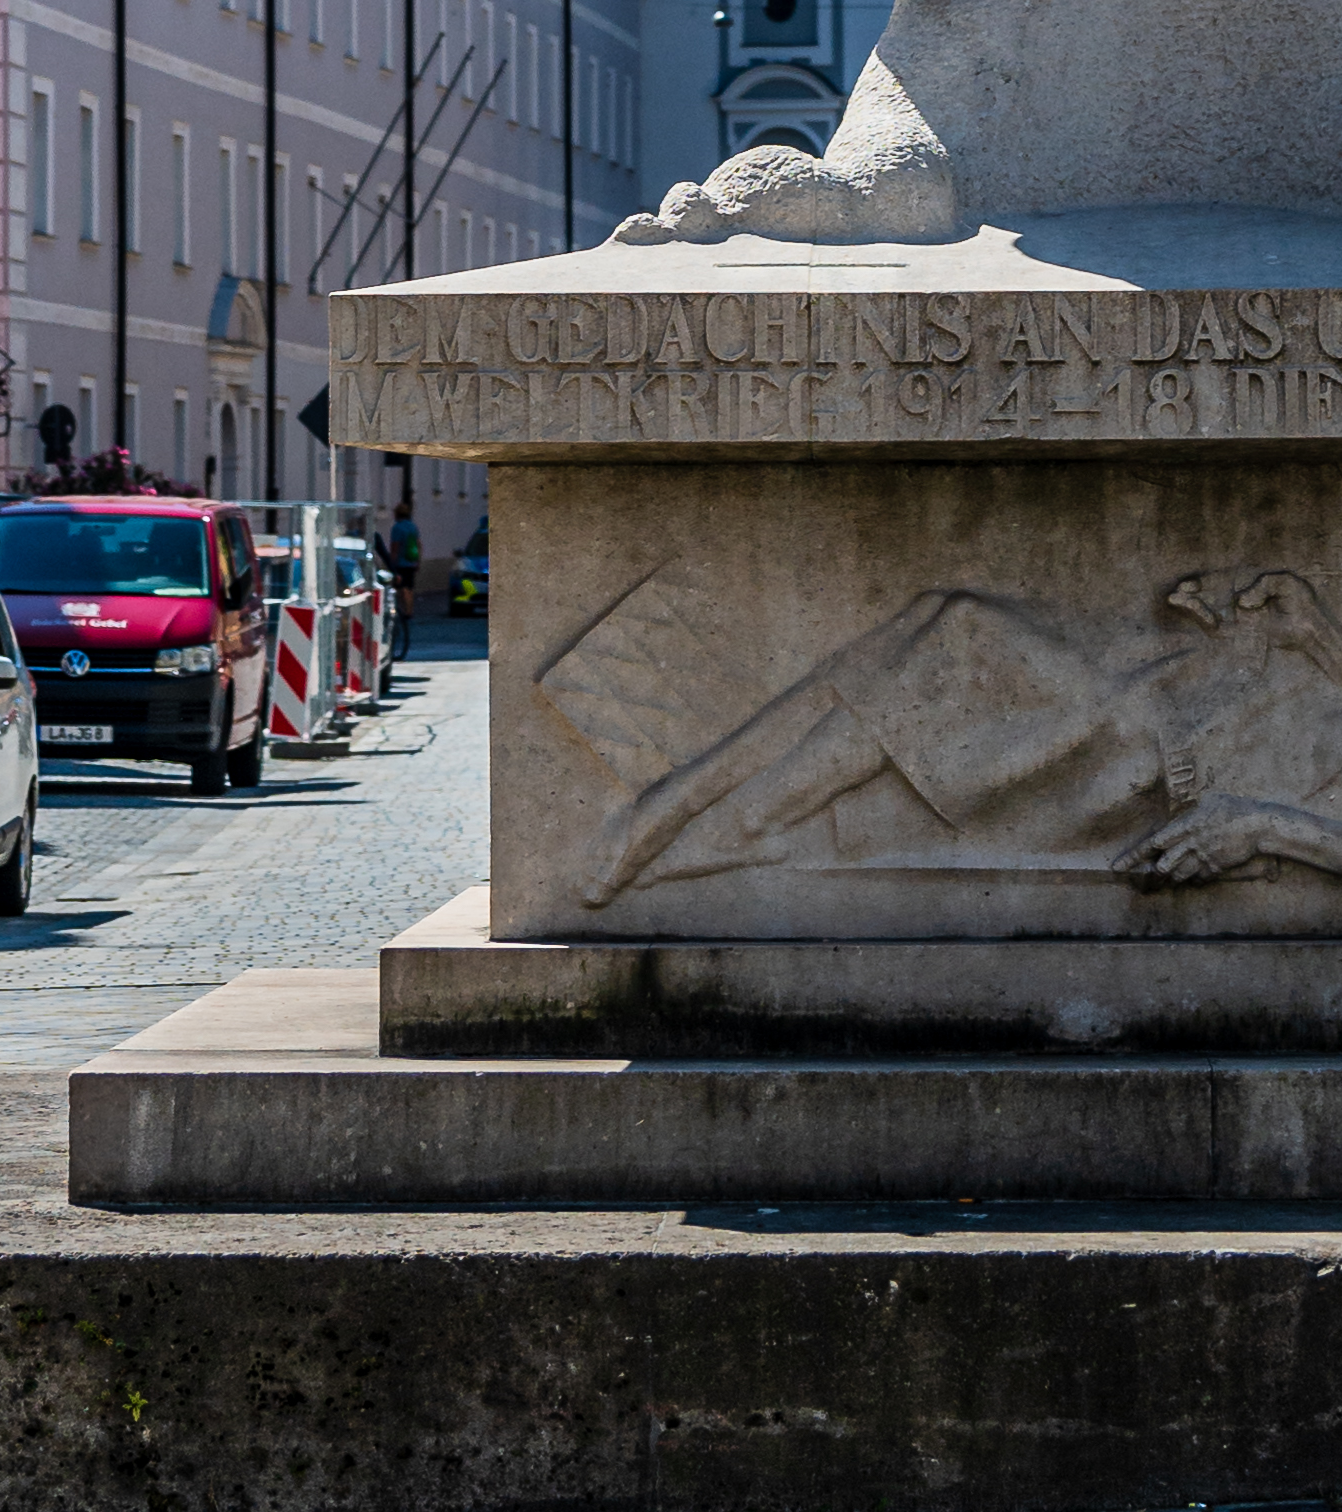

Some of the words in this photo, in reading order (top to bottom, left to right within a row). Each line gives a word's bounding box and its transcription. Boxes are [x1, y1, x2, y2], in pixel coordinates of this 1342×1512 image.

[332, 294, 477, 363] DEM
[1000, 293, 1101, 363] AN
[1131, 291, 1284, 361] DAS
[335, 370, 396, 441] IM
[419, 370, 836, 441] WELTKRIEG
